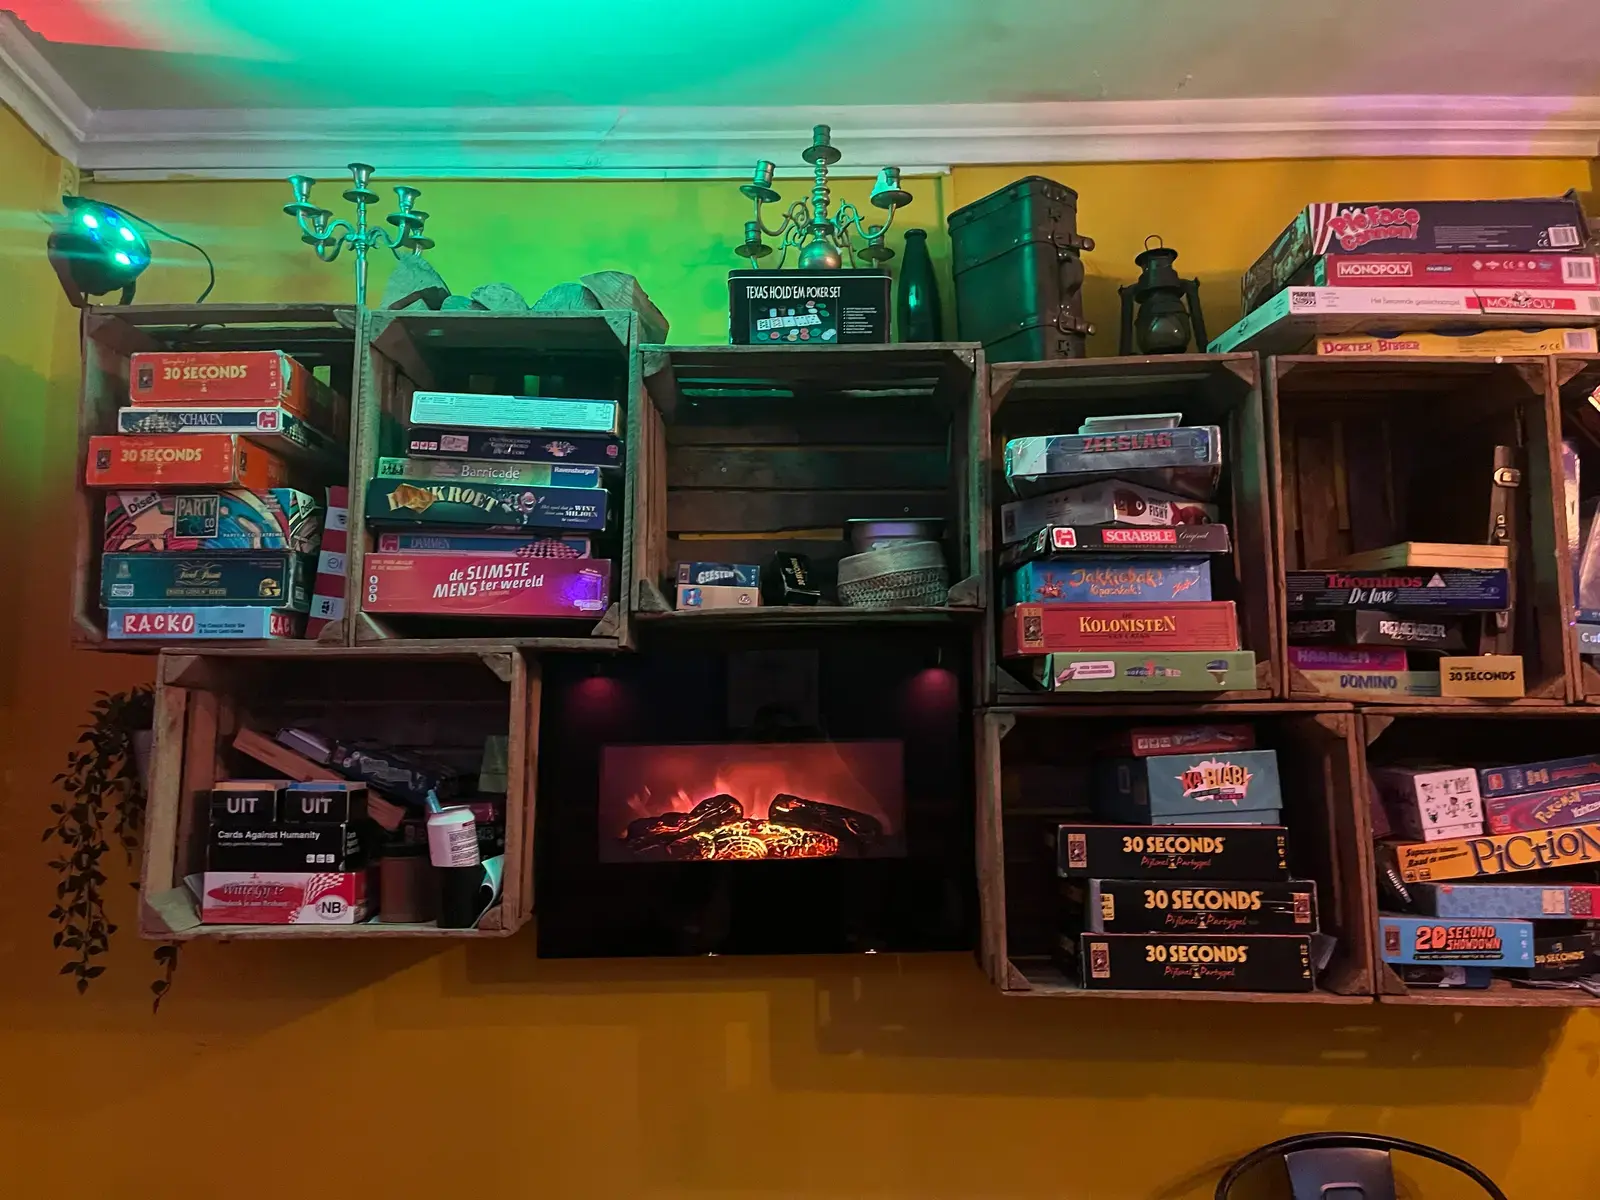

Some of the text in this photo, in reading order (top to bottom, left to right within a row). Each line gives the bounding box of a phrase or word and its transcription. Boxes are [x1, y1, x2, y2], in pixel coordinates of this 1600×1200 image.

[1364, 205, 1421, 227] Face
[1340, 264, 1410, 275] MONOPOLY
[746, 285, 841, 299] TEXAS HOLD'EM POKER SET
[1322, 339, 1420, 354] DOKTER BIBBER
[163, 365, 248, 380] 30 SECONDS
[178, 413, 224, 426] SCHAKEN
[1082, 431, 1172, 453] ZEESLAG
[121, 448, 202, 462] 30 SECONDS
[461, 465, 520, 479] Barricade
[554, 466, 595, 476] Ravensburger
[178, 497, 217, 517] PARTY
[1149, 504, 1168, 520] FISHY
[410, 537, 450, 548] DAMMEN
[1106, 530, 1174, 542] SCRABBLE
[449, 562, 530, 582] de SLIMSTE
[432, 581, 478, 599] MENS
[480, 580, 498, 592] ter
[500, 575, 544, 590] wereld
[1325, 573, 1422, 589] Triominos
[1348, 587, 1396, 605] De Luxe
[1079, 615, 1176, 633] KOLONISTEN
[1379, 620, 1447, 638] REMEMBER
[1448, 670, 1517, 682] 30 SECONDS
[226, 797, 258, 814] UIT
[302, 797, 332, 814] UIT
[217, 830, 321, 840] Cards Against Humanity
[1122, 836, 1225, 854] 30 SECONDS
[1144, 889, 1262, 911] 30 SECONDS
[321, 902, 341, 914] NB
[1415, 925, 1447, 951] 20
[1447, 926, 1496, 939] SECOND
[1446, 938, 1502, 951] SHOWDOWN
[1145, 945, 1248, 963] 30 SECONDS
[1545, 950, 1585, 963] SECONDS
